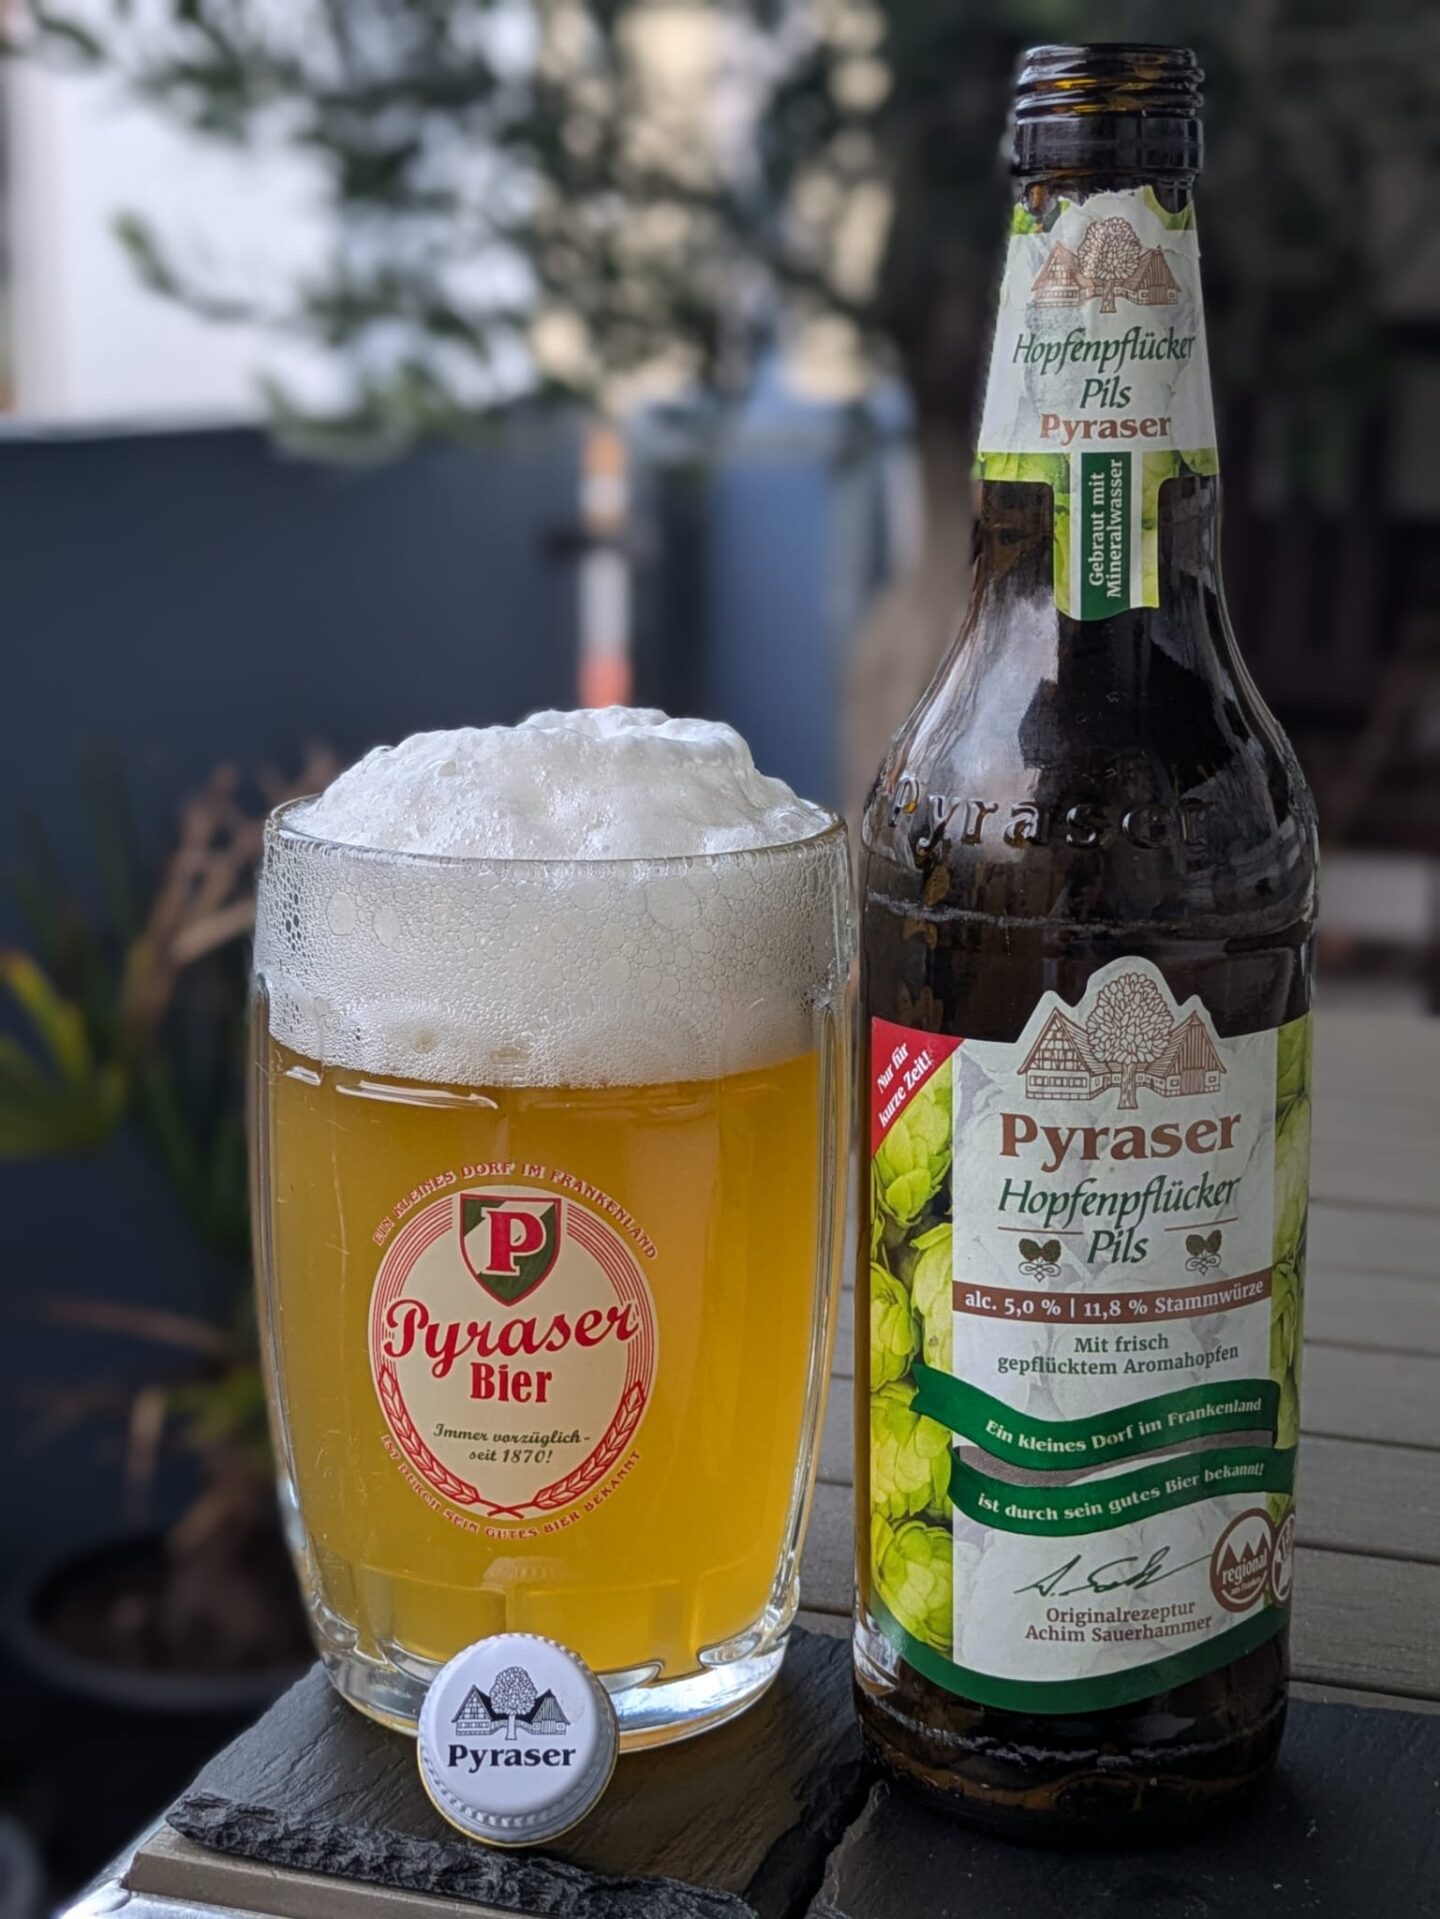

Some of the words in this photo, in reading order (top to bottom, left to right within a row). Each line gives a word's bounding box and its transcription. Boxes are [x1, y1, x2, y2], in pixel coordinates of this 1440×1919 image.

[1013, 327, 1195, 375] Hopfenpflücker
[1079, 375, 1131, 409] Pils
[1040, 413, 1171, 446] Pyraser
[1089, 471, 1105, 504] mit
[1088, 509, 1105, 586] Gebraut
[1106, 459, 1123, 599] Mineralwasser
[877, 1064, 894, 1094] Nur
[892, 1042, 909, 1070] für
[878, 1086, 906, 1128] kurze
[903, 1050, 932, 1091] Zeit!
[999, 1112, 1241, 1173] Pyraser
[372, 1217, 395, 1247] EIN
[393, 1170, 457, 1219] KLEINES
[461, 1162, 516, 1179] DORF
[522, 1163, 546, 1179] IM
[550, 1169, 658, 1260] FRANKENLAND
[997, 1171, 1240, 1230] Hopfenpflücker
[484, 1208, 546, 1275] P
[1087, 1225, 1149, 1265] Pils
[965, 1290, 997, 1311] alc.
[1003, 1299, 1034, 1319] 5,0
[1041, 1299, 1062, 1317] %
[1083, 1301, 1122, 1320] 11,8
[1128, 1299, 1149, 1317] %
[1154, 1279, 1264, 1314] Stammwürze
[384, 1299, 640, 1379] Pyraser
[997, 1354, 1117, 1375] gepflücktem
[1124, 1344, 1240, 1375] Aromahopfen
[1074, 1335, 1109, 1354] Mit
[1114, 1333, 1170, 1353] frisch
[470, 1362, 553, 1403] Bier
[433, 1423, 488, 1441] Immer
[984, 1419, 1014, 1445] Ein
[1017, 1432, 1087, 1454] kleines
[1092, 1425, 1136, 1450] Dorf
[1139, 1419, 1163, 1438] im
[1168, 1397, 1262, 1426] Frankenland
[469, 1448, 498, 1462] seit
[502, 1448, 553, 1464] 1870!
[543, 1511, 580, 1534] BIER
[584, 1450, 640, 1513] BEKANNT
[978, 1492, 1000, 1515] ist
[1005, 1501, 1059, 1521] durch
[1064, 1501, 1103, 1520] sein
[1108, 1487, 1161, 1515] gutes
[1164, 1473, 1201, 1495] Bier
[1204, 1463, 1265, 1483] bekannt!
[1222, 1548, 1268, 1586] regional
[1025, 1624, 1086, 1643] Achim
[1091, 1615, 1212, 1643] Sauerhammer
[1046, 1602, 1196, 1626] Originalrezeptur
[447, 1743, 576, 1774] Pyraser
